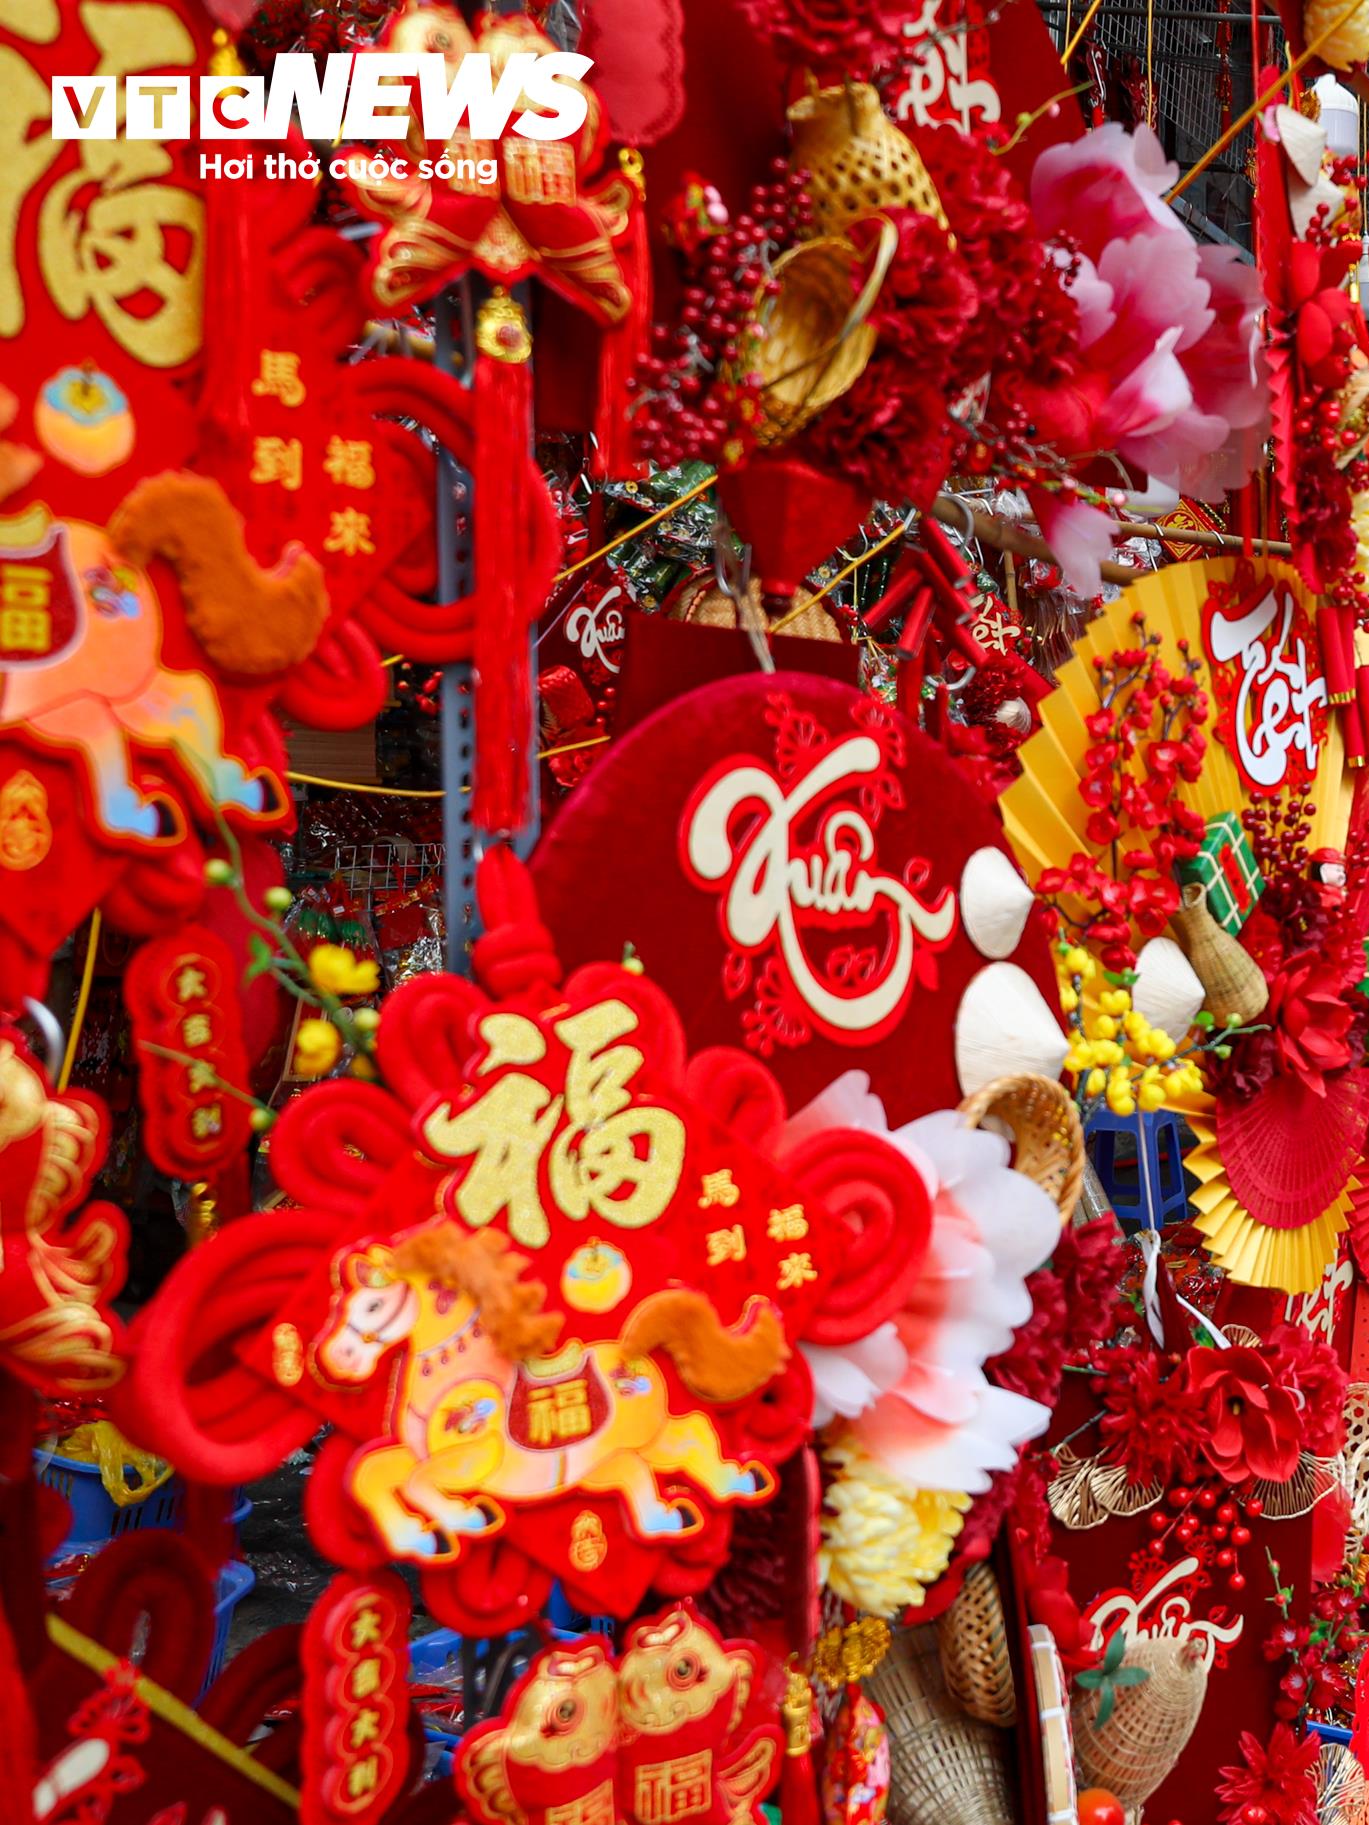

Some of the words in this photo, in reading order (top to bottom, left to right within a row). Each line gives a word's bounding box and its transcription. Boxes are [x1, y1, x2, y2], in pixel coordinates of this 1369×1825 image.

[1210, 589, 1328, 786] Tết
[688, 736, 957, 1030] Xuân
[424, 998, 687, 1249] 福
[527, 1378, 592, 1445] 福
[634, 1749, 713, 1825] 福
